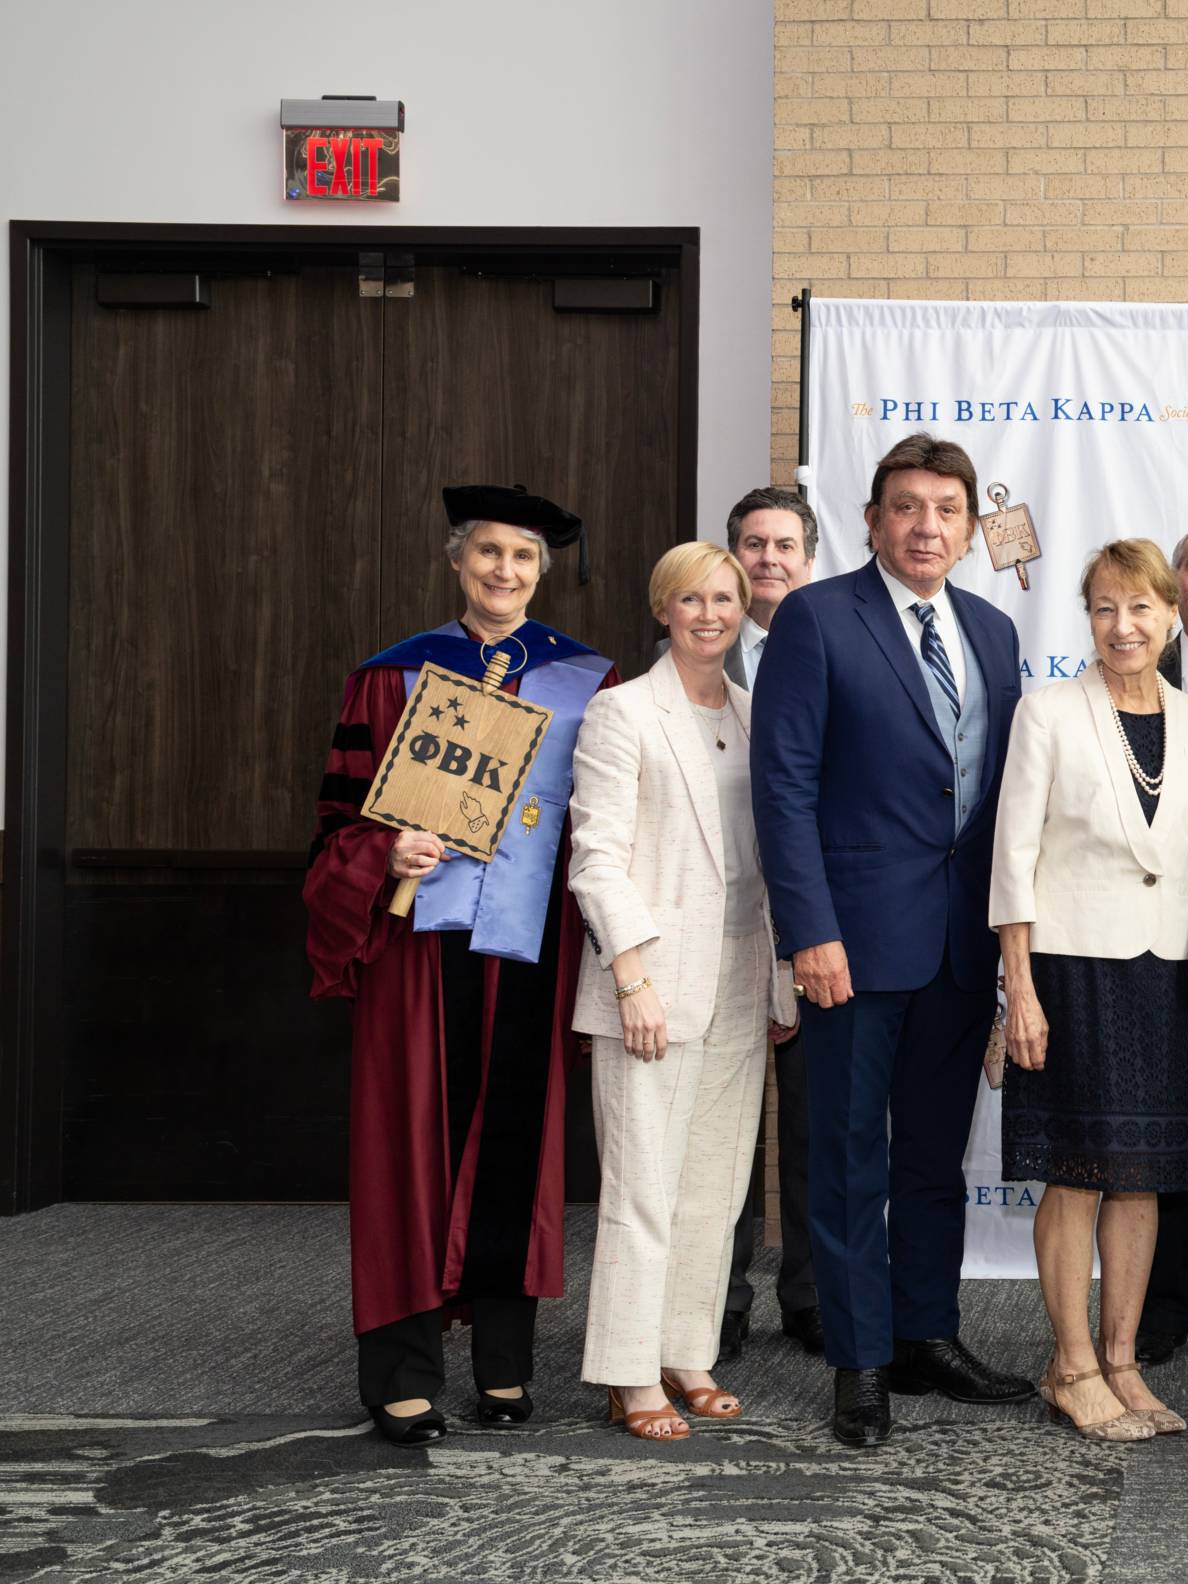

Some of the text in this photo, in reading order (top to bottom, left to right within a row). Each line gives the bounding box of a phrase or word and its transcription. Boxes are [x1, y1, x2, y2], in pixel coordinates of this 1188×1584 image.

[307, 137, 384, 196] EXIT
[852, 403, 874, 417] The
[880, 399, 940, 422] PHI
[954, 400, 1040, 422] BETA
[1051, 398, 1155, 423] KAPPA
[964, 1186, 1037, 1206] ETA
